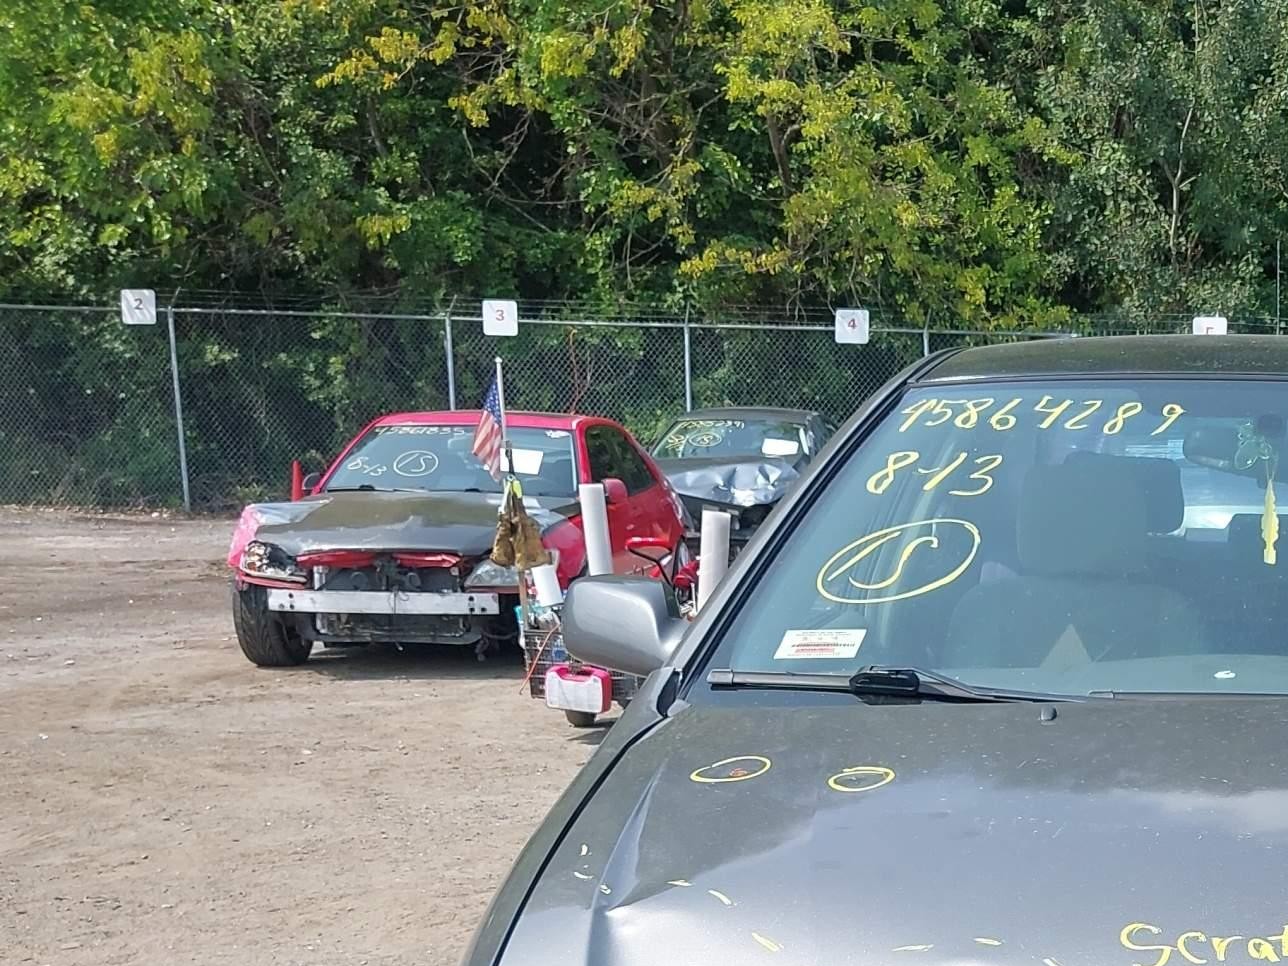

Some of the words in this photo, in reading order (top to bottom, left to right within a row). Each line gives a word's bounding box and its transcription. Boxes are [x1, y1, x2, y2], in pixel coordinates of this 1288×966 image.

[134, 298, 143, 311] 2
[496, 309, 505, 321] 3
[848, 319, 856, 330] 4
[866, 451, 1003, 496] 8-13
